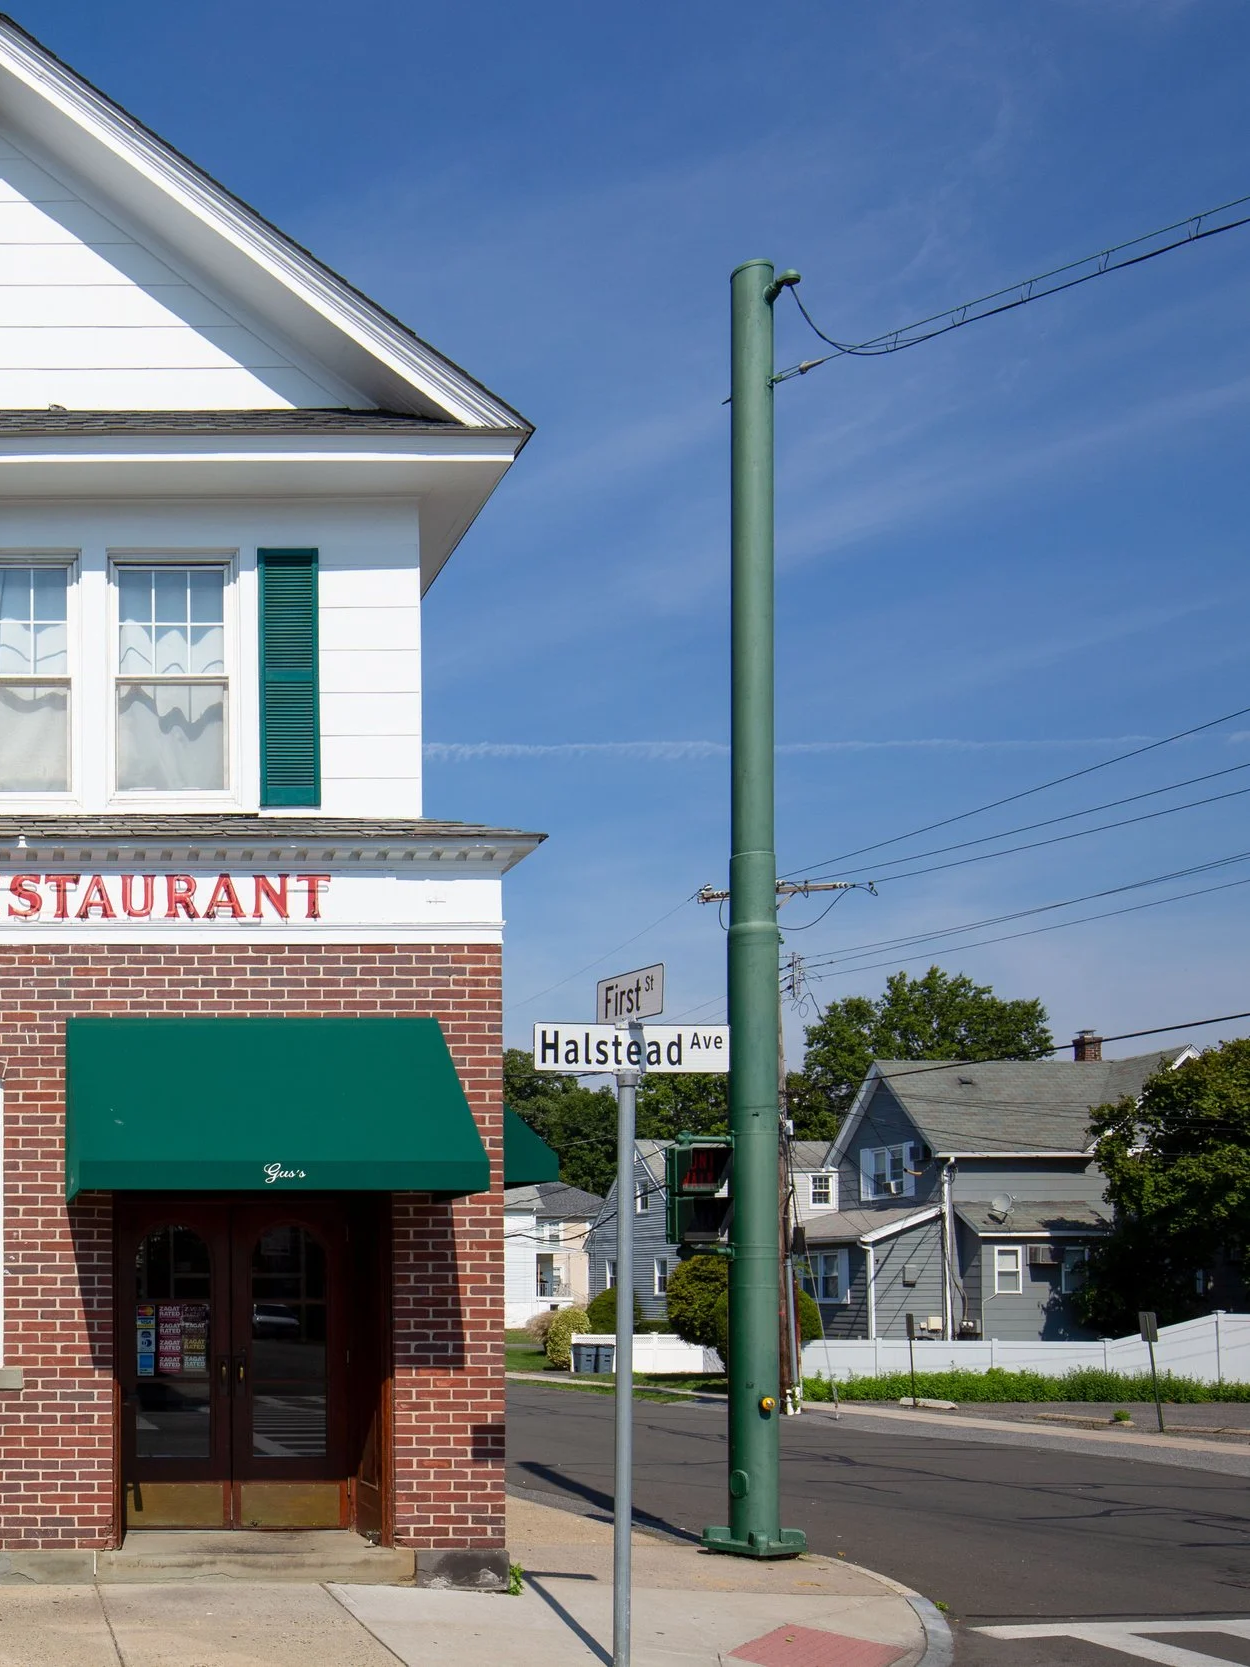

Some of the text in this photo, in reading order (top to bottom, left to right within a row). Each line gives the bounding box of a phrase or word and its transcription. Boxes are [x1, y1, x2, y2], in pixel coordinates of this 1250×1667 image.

[604, 974, 654, 1019] First St
[541, 1030, 723, 1066] Halstead Ave
[263, 1163, 307, 1184] Gus's
